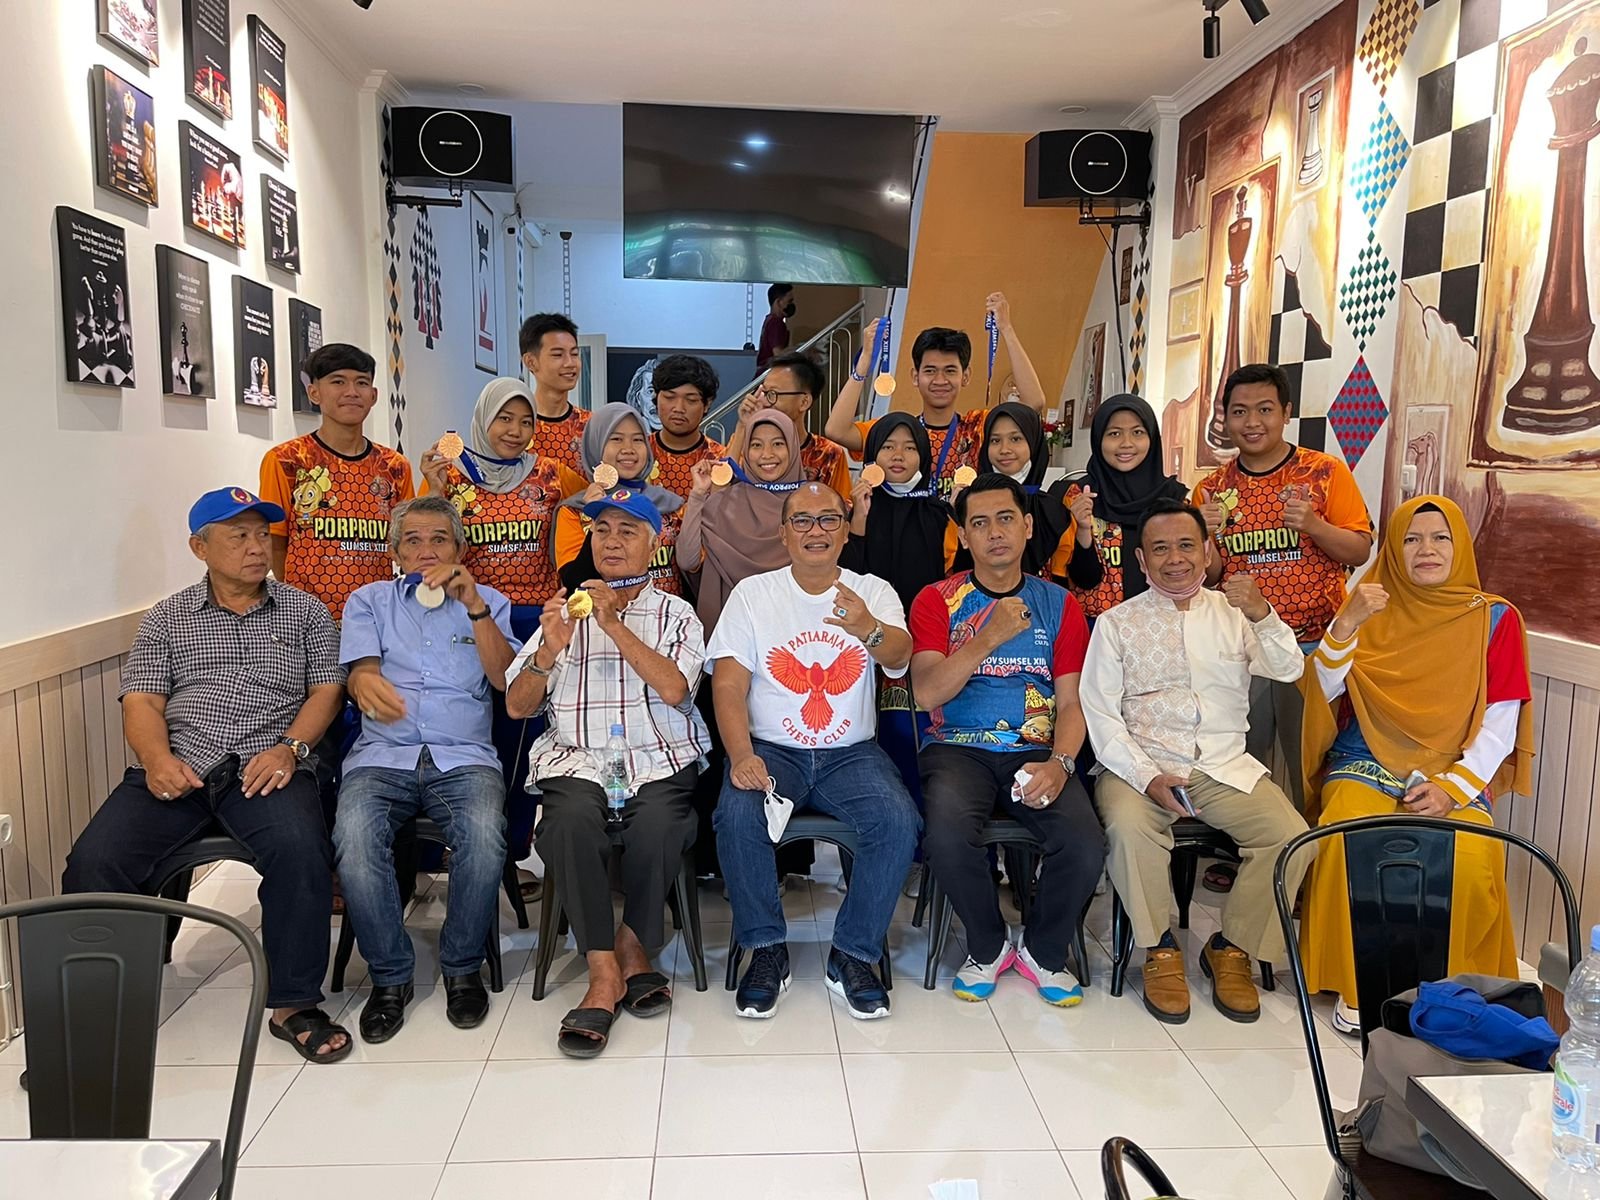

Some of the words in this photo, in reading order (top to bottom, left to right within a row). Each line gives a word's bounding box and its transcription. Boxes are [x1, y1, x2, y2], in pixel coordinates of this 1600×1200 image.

[314, 517, 388, 540] PORPROV
[340, 541, 374, 551] SUMSEL
[374, 543, 388, 552] XIII
[524, 542, 540, 552] XIII
[1247, 552, 1283, 564] SUMSEL
[1284, 550, 1302, 561] XIII
[787, 630, 846, 651] PATIARAJA
[998, 657, 1033, 666] SUMSEL
[782, 717, 817, 747] CHESS
[823, 718, 852, 745] CLUB
